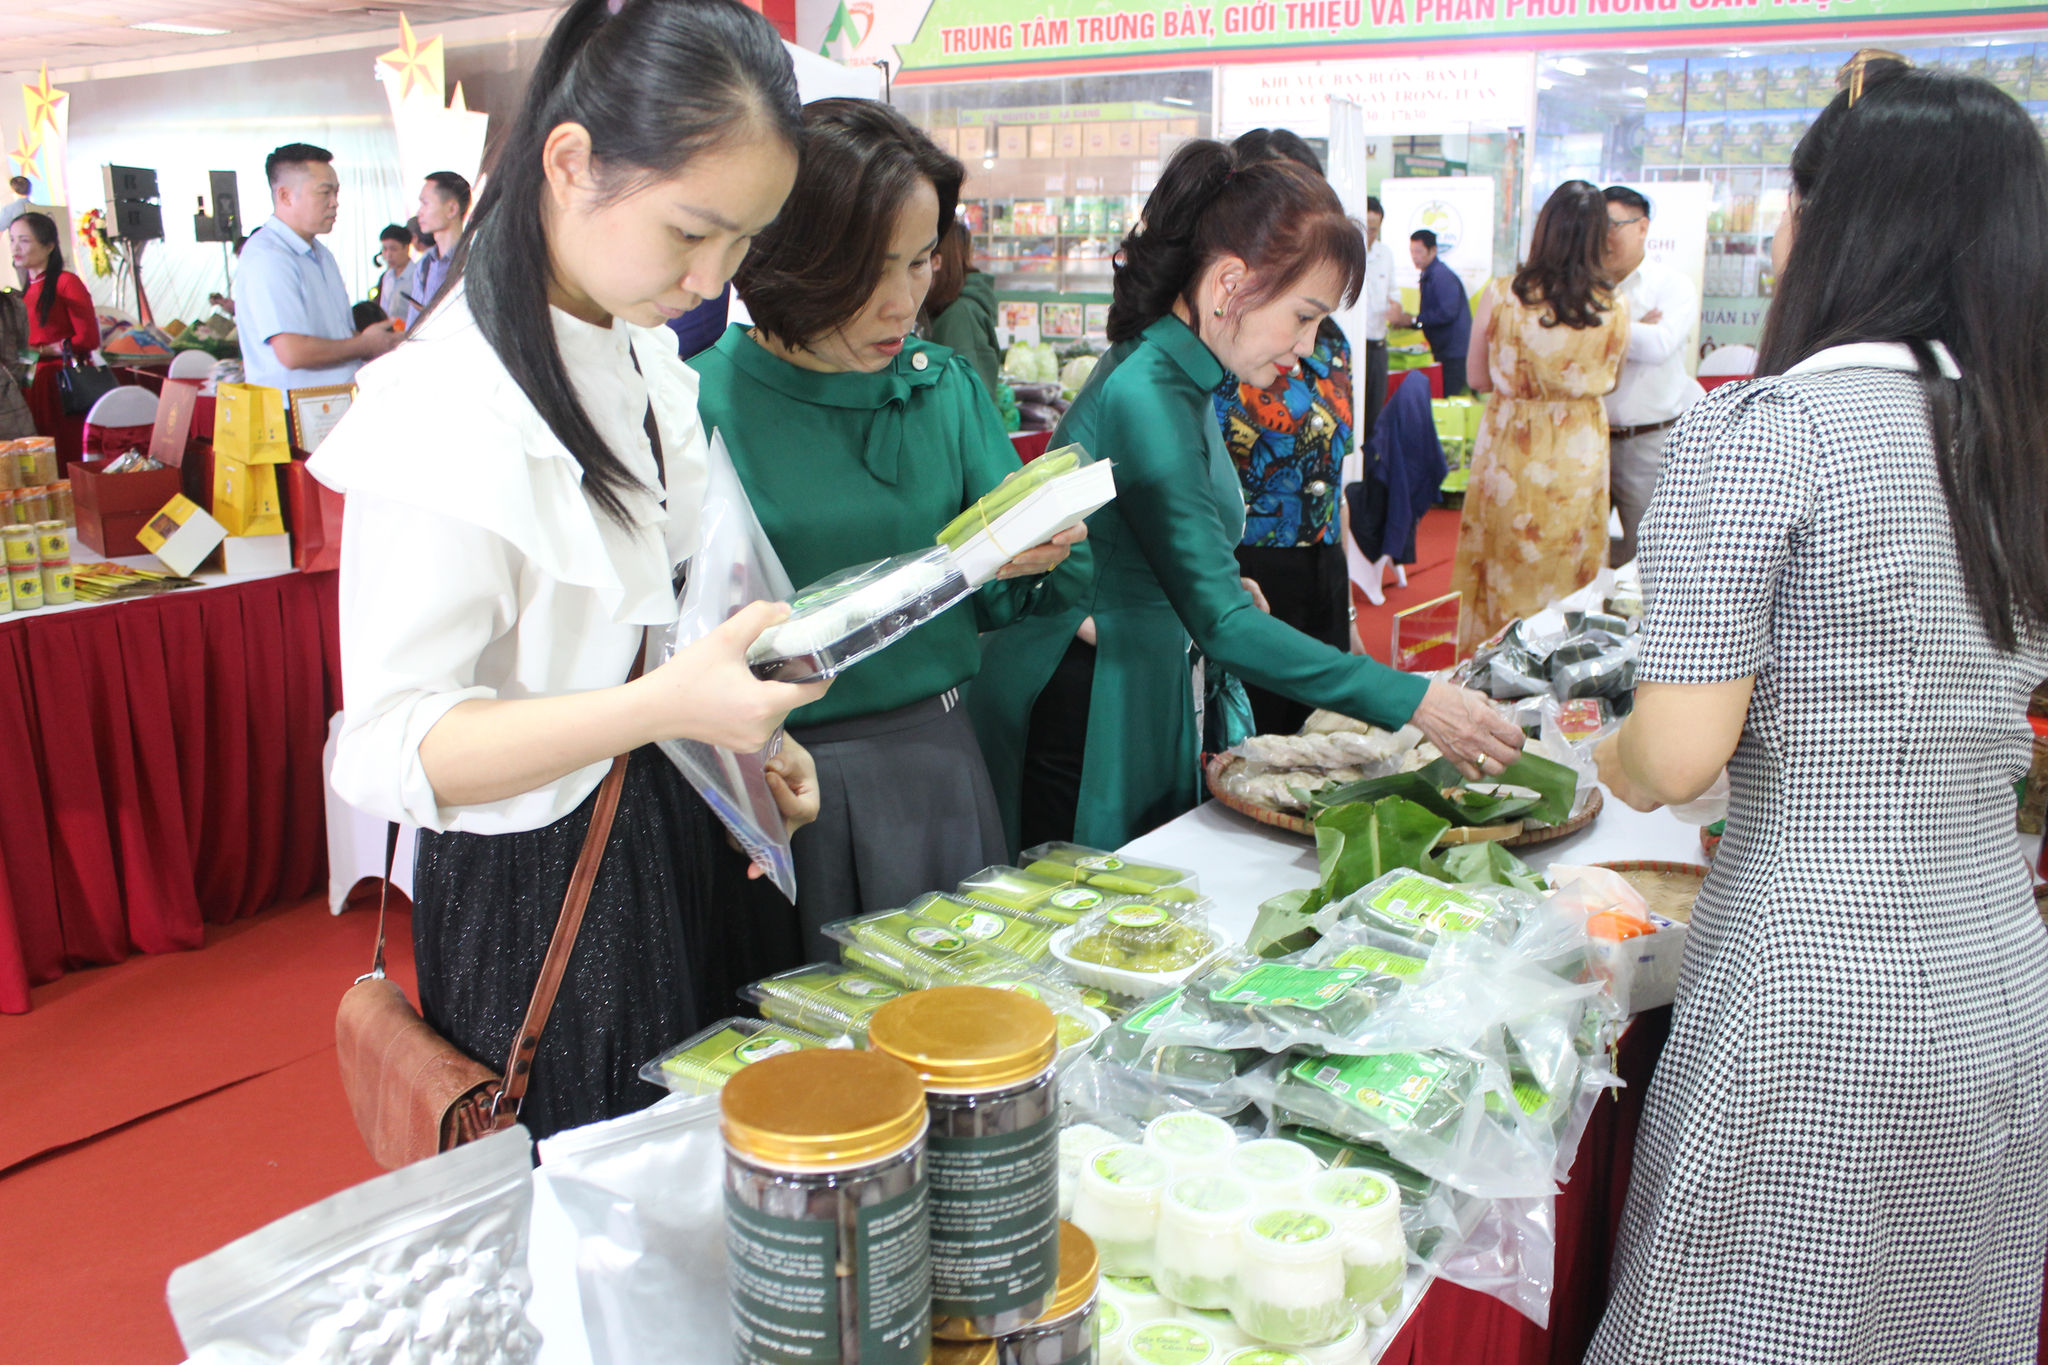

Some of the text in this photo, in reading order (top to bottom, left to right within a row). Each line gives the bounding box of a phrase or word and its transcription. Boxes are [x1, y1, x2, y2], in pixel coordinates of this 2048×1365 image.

[942, 25, 1012, 53] TRUNG
[1020, 15, 1068, 47] TÂM
[1077, 12, 1155, 42] TRƯNG
[1163, 3, 1215, 38] BÀY,
[1224, 0, 1276, 33] GIỚI
